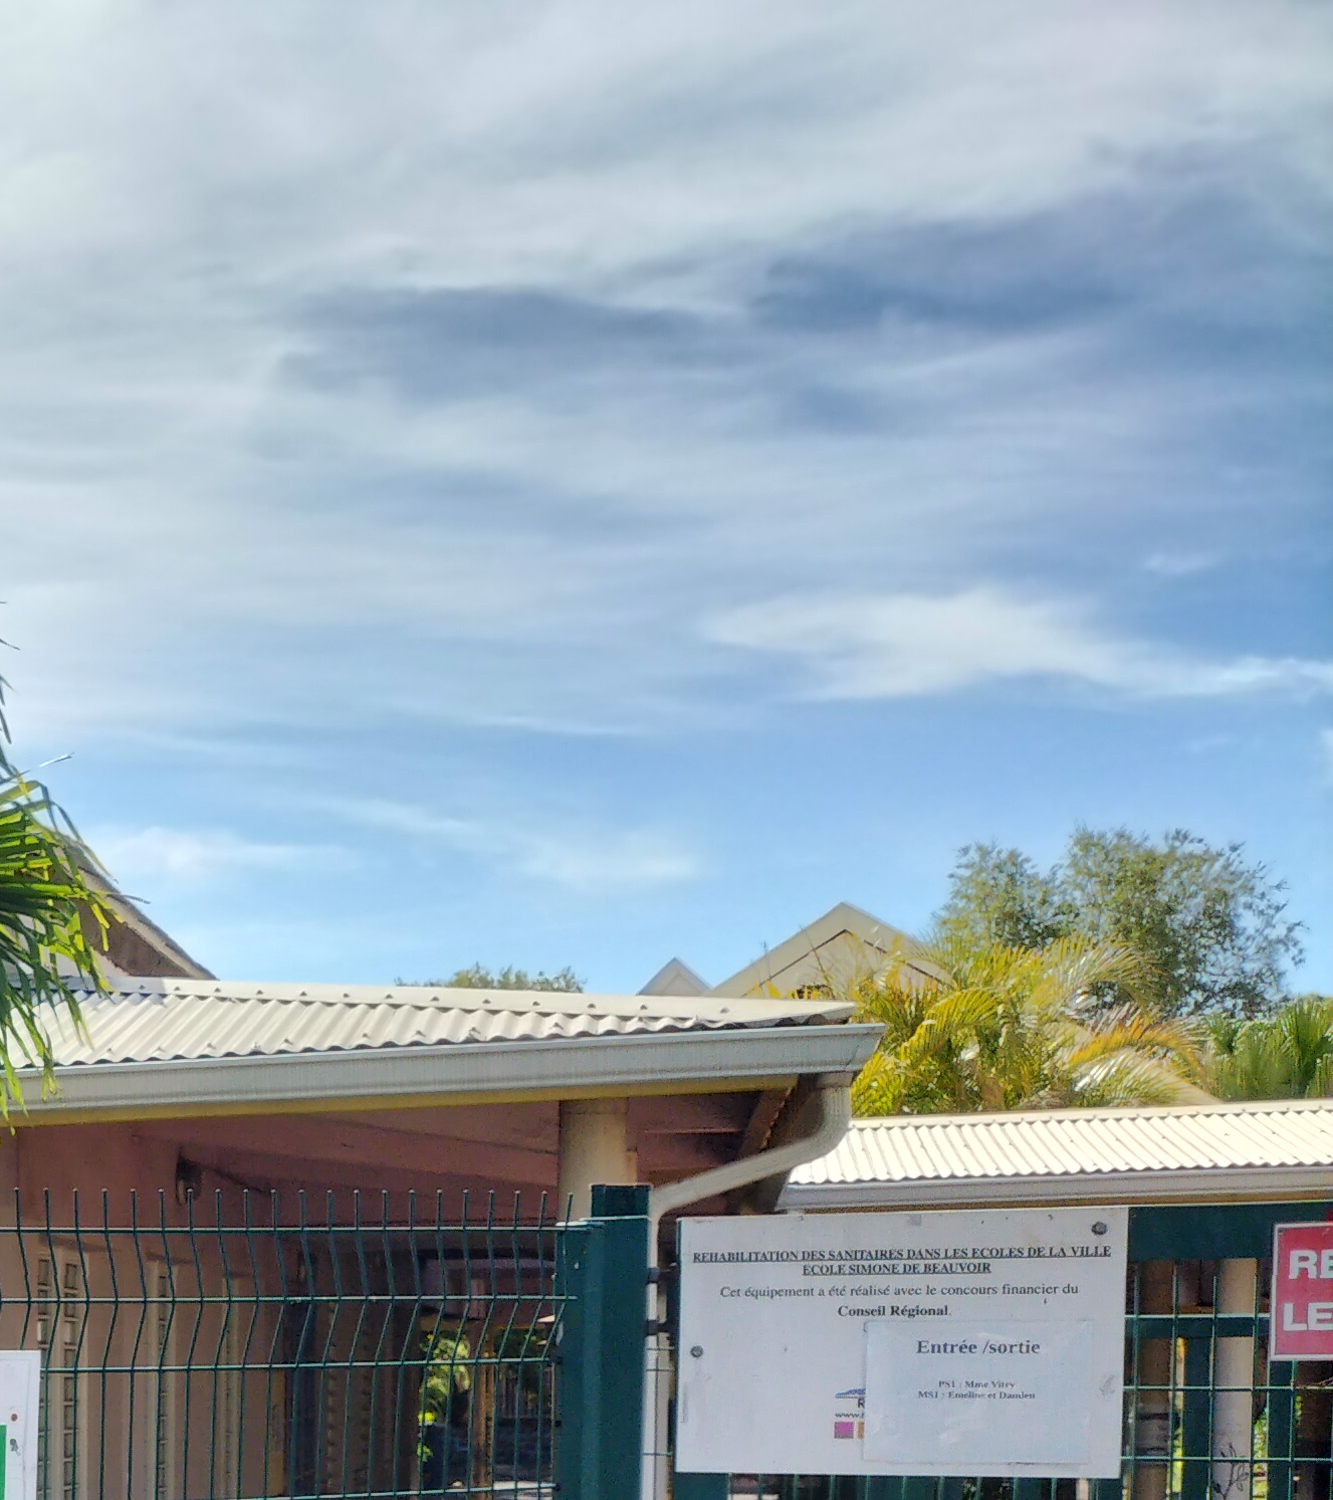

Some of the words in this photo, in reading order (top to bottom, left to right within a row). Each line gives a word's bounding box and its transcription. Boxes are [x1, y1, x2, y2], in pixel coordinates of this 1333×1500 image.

[693, 1250, 798, 1263] REHABILITATION
[802, 1250, 825, 1261] DES
[829, 1249, 903, 1261] SANITAIRES
[907, 1248, 940, 1259] DANS
[945, 1248, 968, 1259] LES
[972, 1247, 1024, 1258] ECOLES
[1027, 1247, 1045, 1258] DE
[1049, 1247, 1066, 1257] LA
[1071, 1246, 1111, 1257] VILLE
[802, 1264, 845, 1275] ECOLE
[849, 1264, 899, 1275] SIMONE
[903, 1263, 920, 1274] DE
[924, 1262, 991, 1274] BEAUVOIR
[720, 1286, 740, 1297] Cet
[745, 1285, 814, 1299] équipement
[818, 1288, 825, 1297] a
[829, 1285, 846, 1296] été
[850, 1285, 890, 1296] réalisé
[894, 1286, 921, 1295] avec
[925, 1284, 936, 1295] le
[941, 1286, 998, 1295] concours
[1002, 1284, 1057, 1294] financier
[1062, 1284, 1078, 1294] du
[838, 1305, 885, 1316] Conseil
[916, 1339, 978, 1354] Entrée
[983, 1339, 1040, 1354] /sortie
